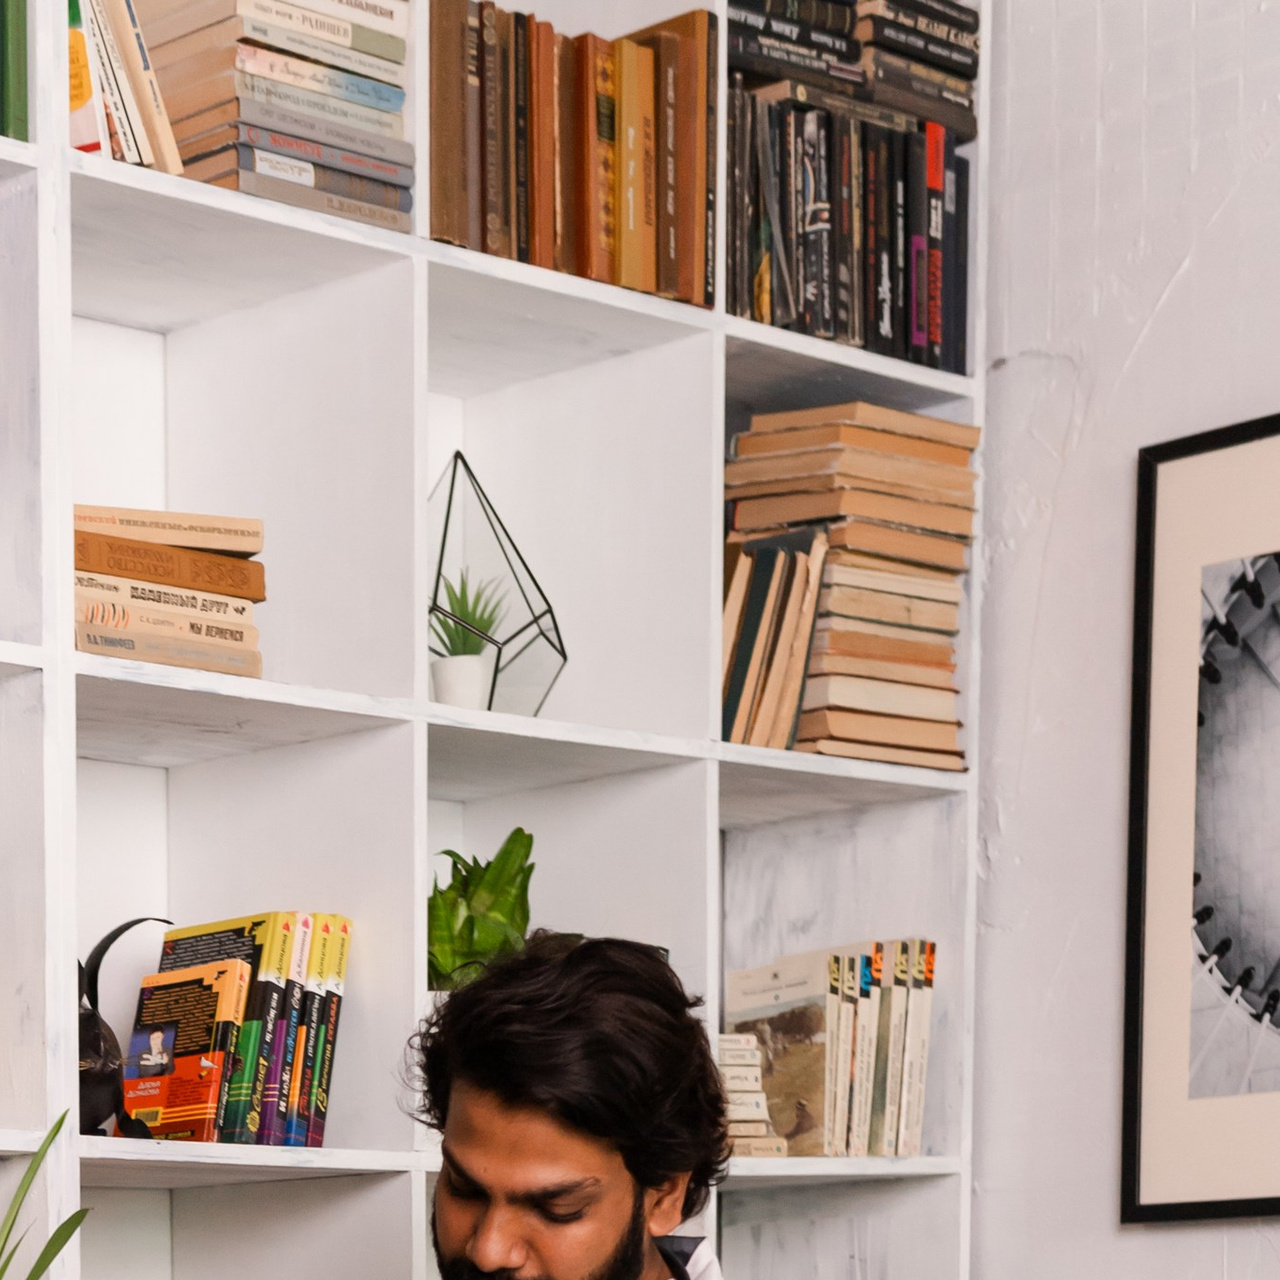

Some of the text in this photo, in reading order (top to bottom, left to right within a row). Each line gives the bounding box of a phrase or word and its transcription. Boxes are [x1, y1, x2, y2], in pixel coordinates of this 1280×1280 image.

[316, 936, 328, 978] Донцова
[251, 932, 288, 1111] Скелет Донцова
